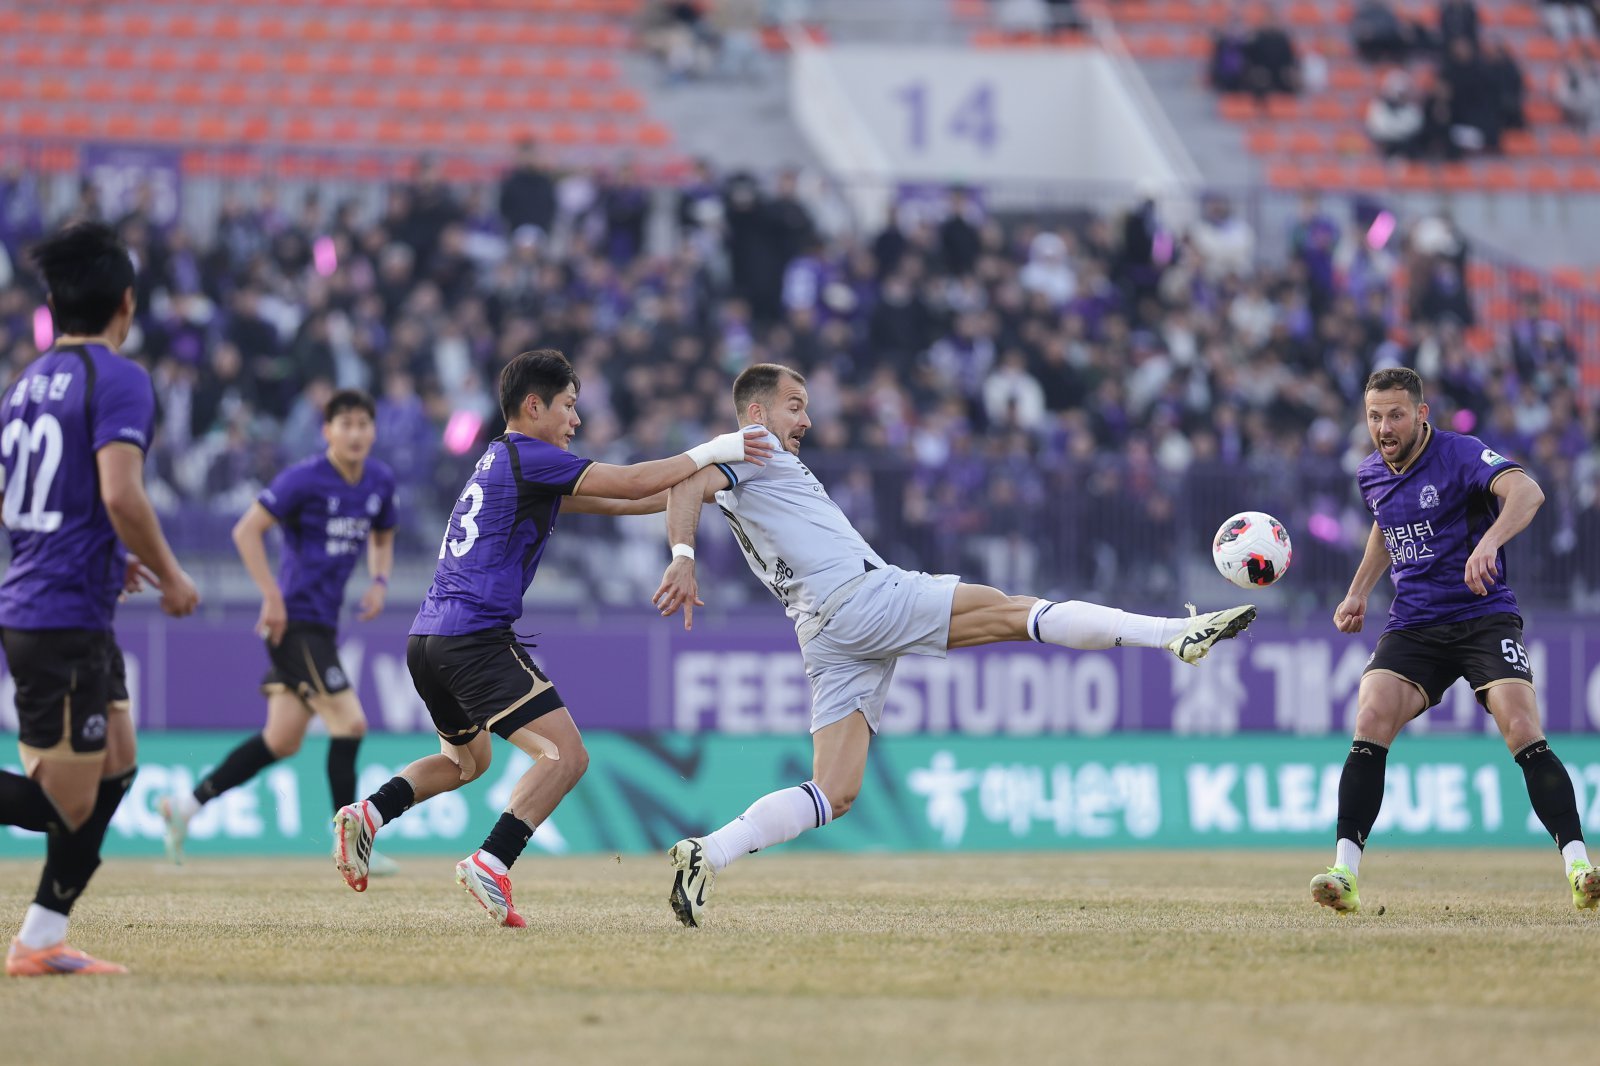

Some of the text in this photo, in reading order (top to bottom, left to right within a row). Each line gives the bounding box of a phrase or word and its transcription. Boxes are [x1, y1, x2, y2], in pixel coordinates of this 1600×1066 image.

[889, 80, 1003, 152] 14
[1, 413, 63, 532] 22
[1501, 638, 1530, 669] 55
[672, 651, 810, 734] FEE
[878, 654, 1120, 736] STUDIO
[1350, 746, 1373, 756] CA
[979, 760, 1162, 838] 하나은행
[1187, 762, 1241, 833] K
[1244, 762, 1471, 833] LEUE
[1473, 763, 1502, 833] 1
